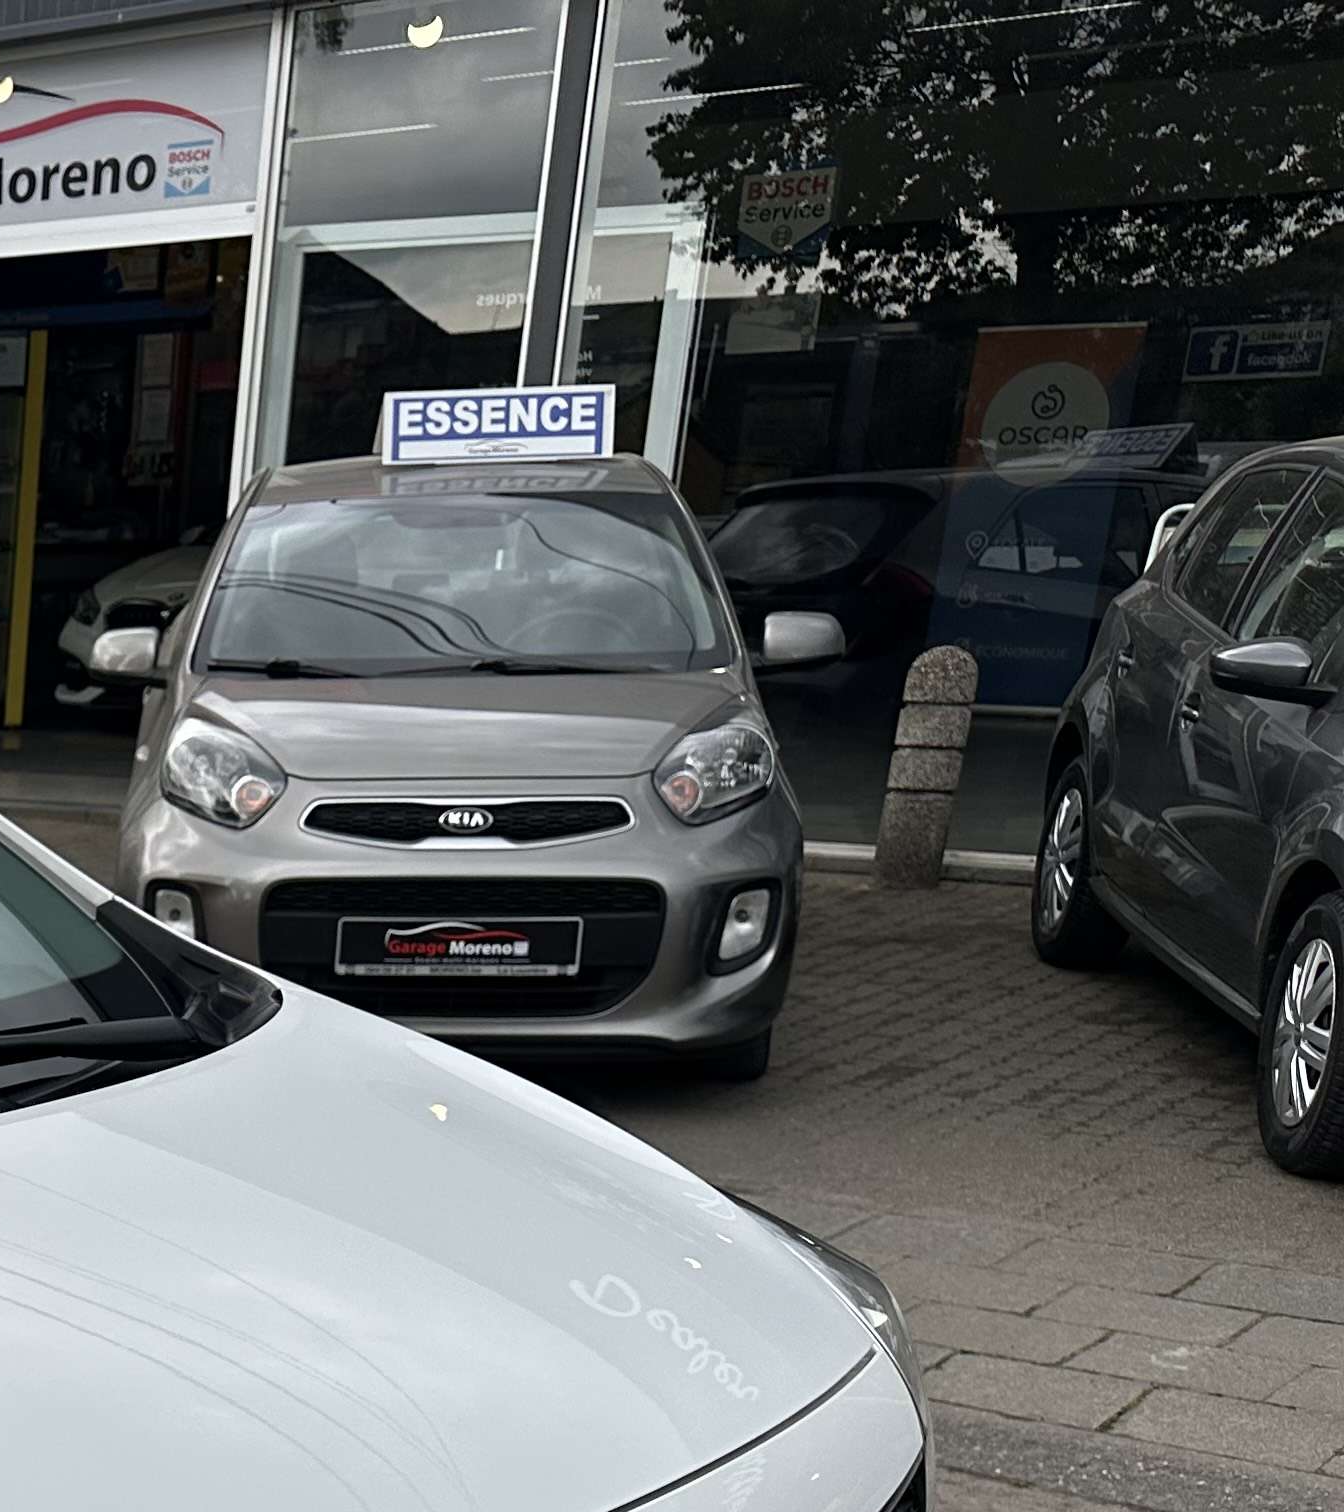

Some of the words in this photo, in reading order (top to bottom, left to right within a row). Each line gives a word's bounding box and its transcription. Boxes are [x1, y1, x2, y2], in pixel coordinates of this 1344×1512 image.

[168, 149, 210, 164] BOSCH
[167, 165, 209, 177] Service
[748, 175, 829, 200] BOSCH
[744, 203, 825, 224] Service
[399, 395, 597, 436] ESSENCE
[998, 425, 1089, 446] OSCAR
[448, 811, 484, 827] KIA
[388, 941, 447, 956] Garage
[449, 941, 512, 955] Moreno
